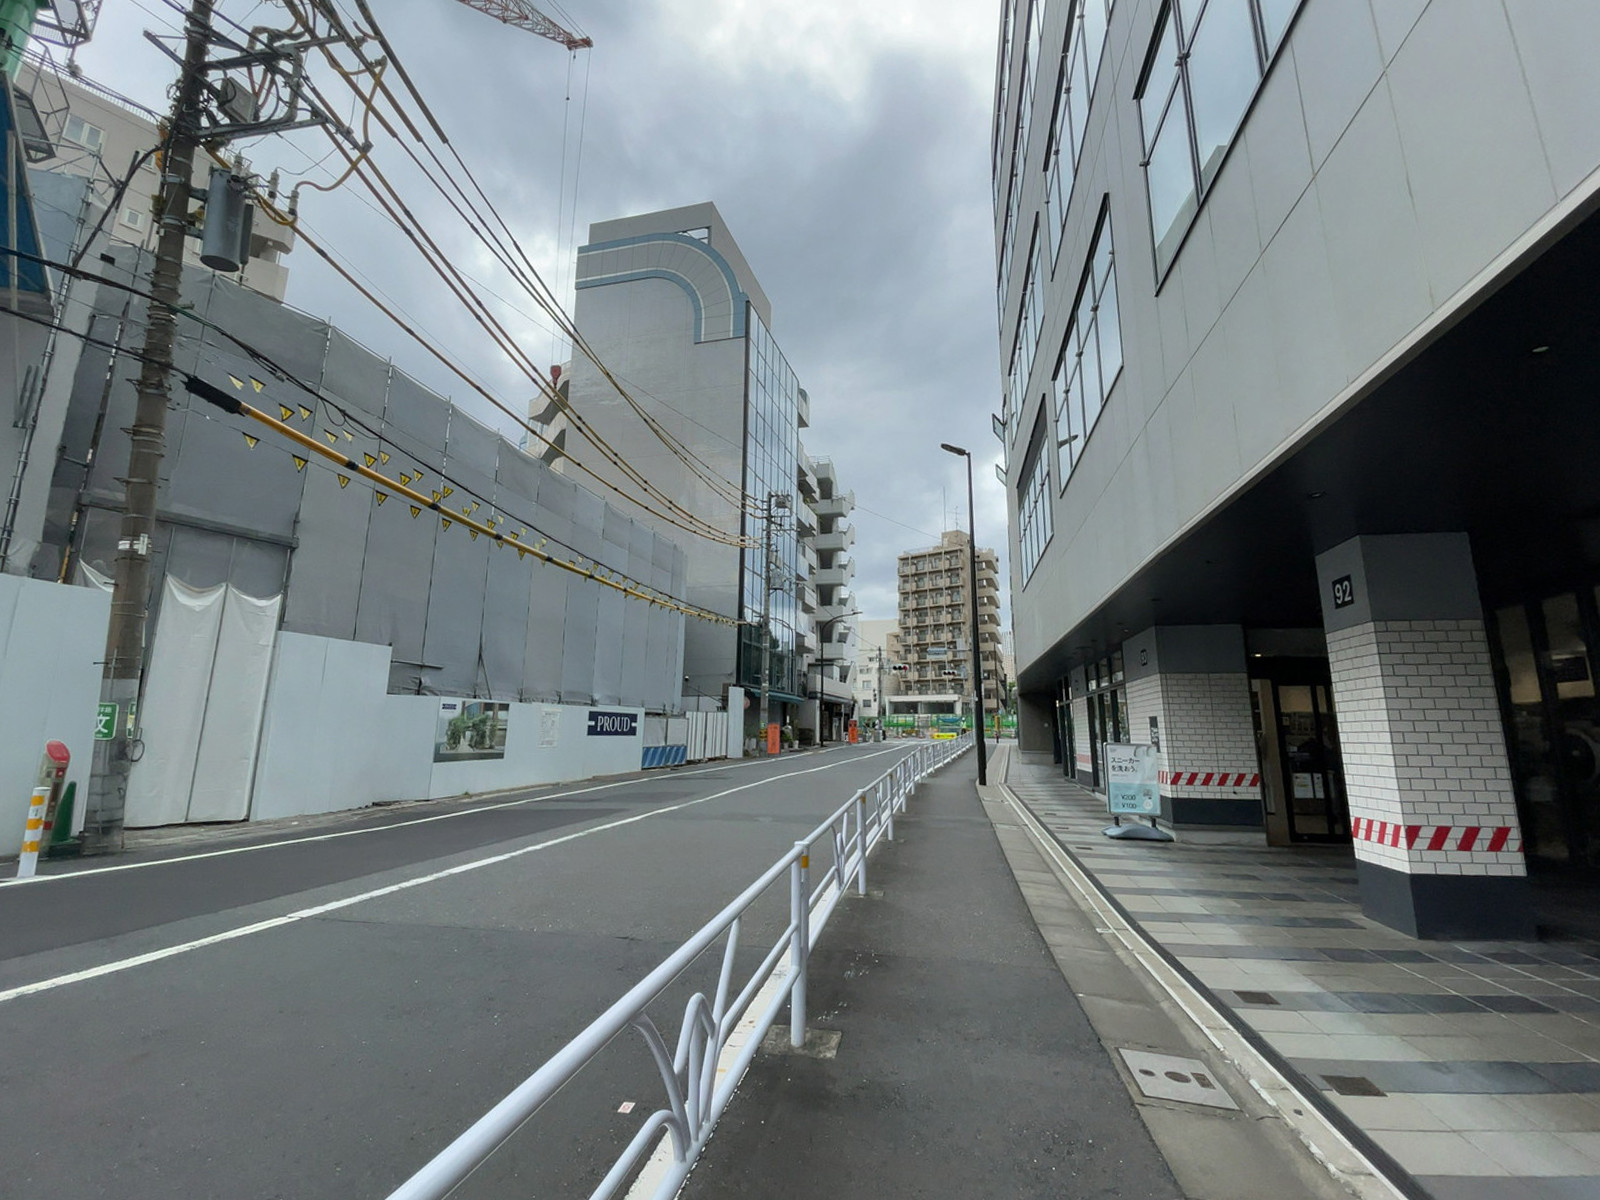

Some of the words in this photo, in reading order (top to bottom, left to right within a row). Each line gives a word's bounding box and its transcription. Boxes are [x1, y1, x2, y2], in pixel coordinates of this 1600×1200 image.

[1335, 581, 1352, 604] 92
[94, 713, 110, 733] 文
[597, 715, 631, 732] PROUD
[1111, 756, 1140, 765] スニーカー
